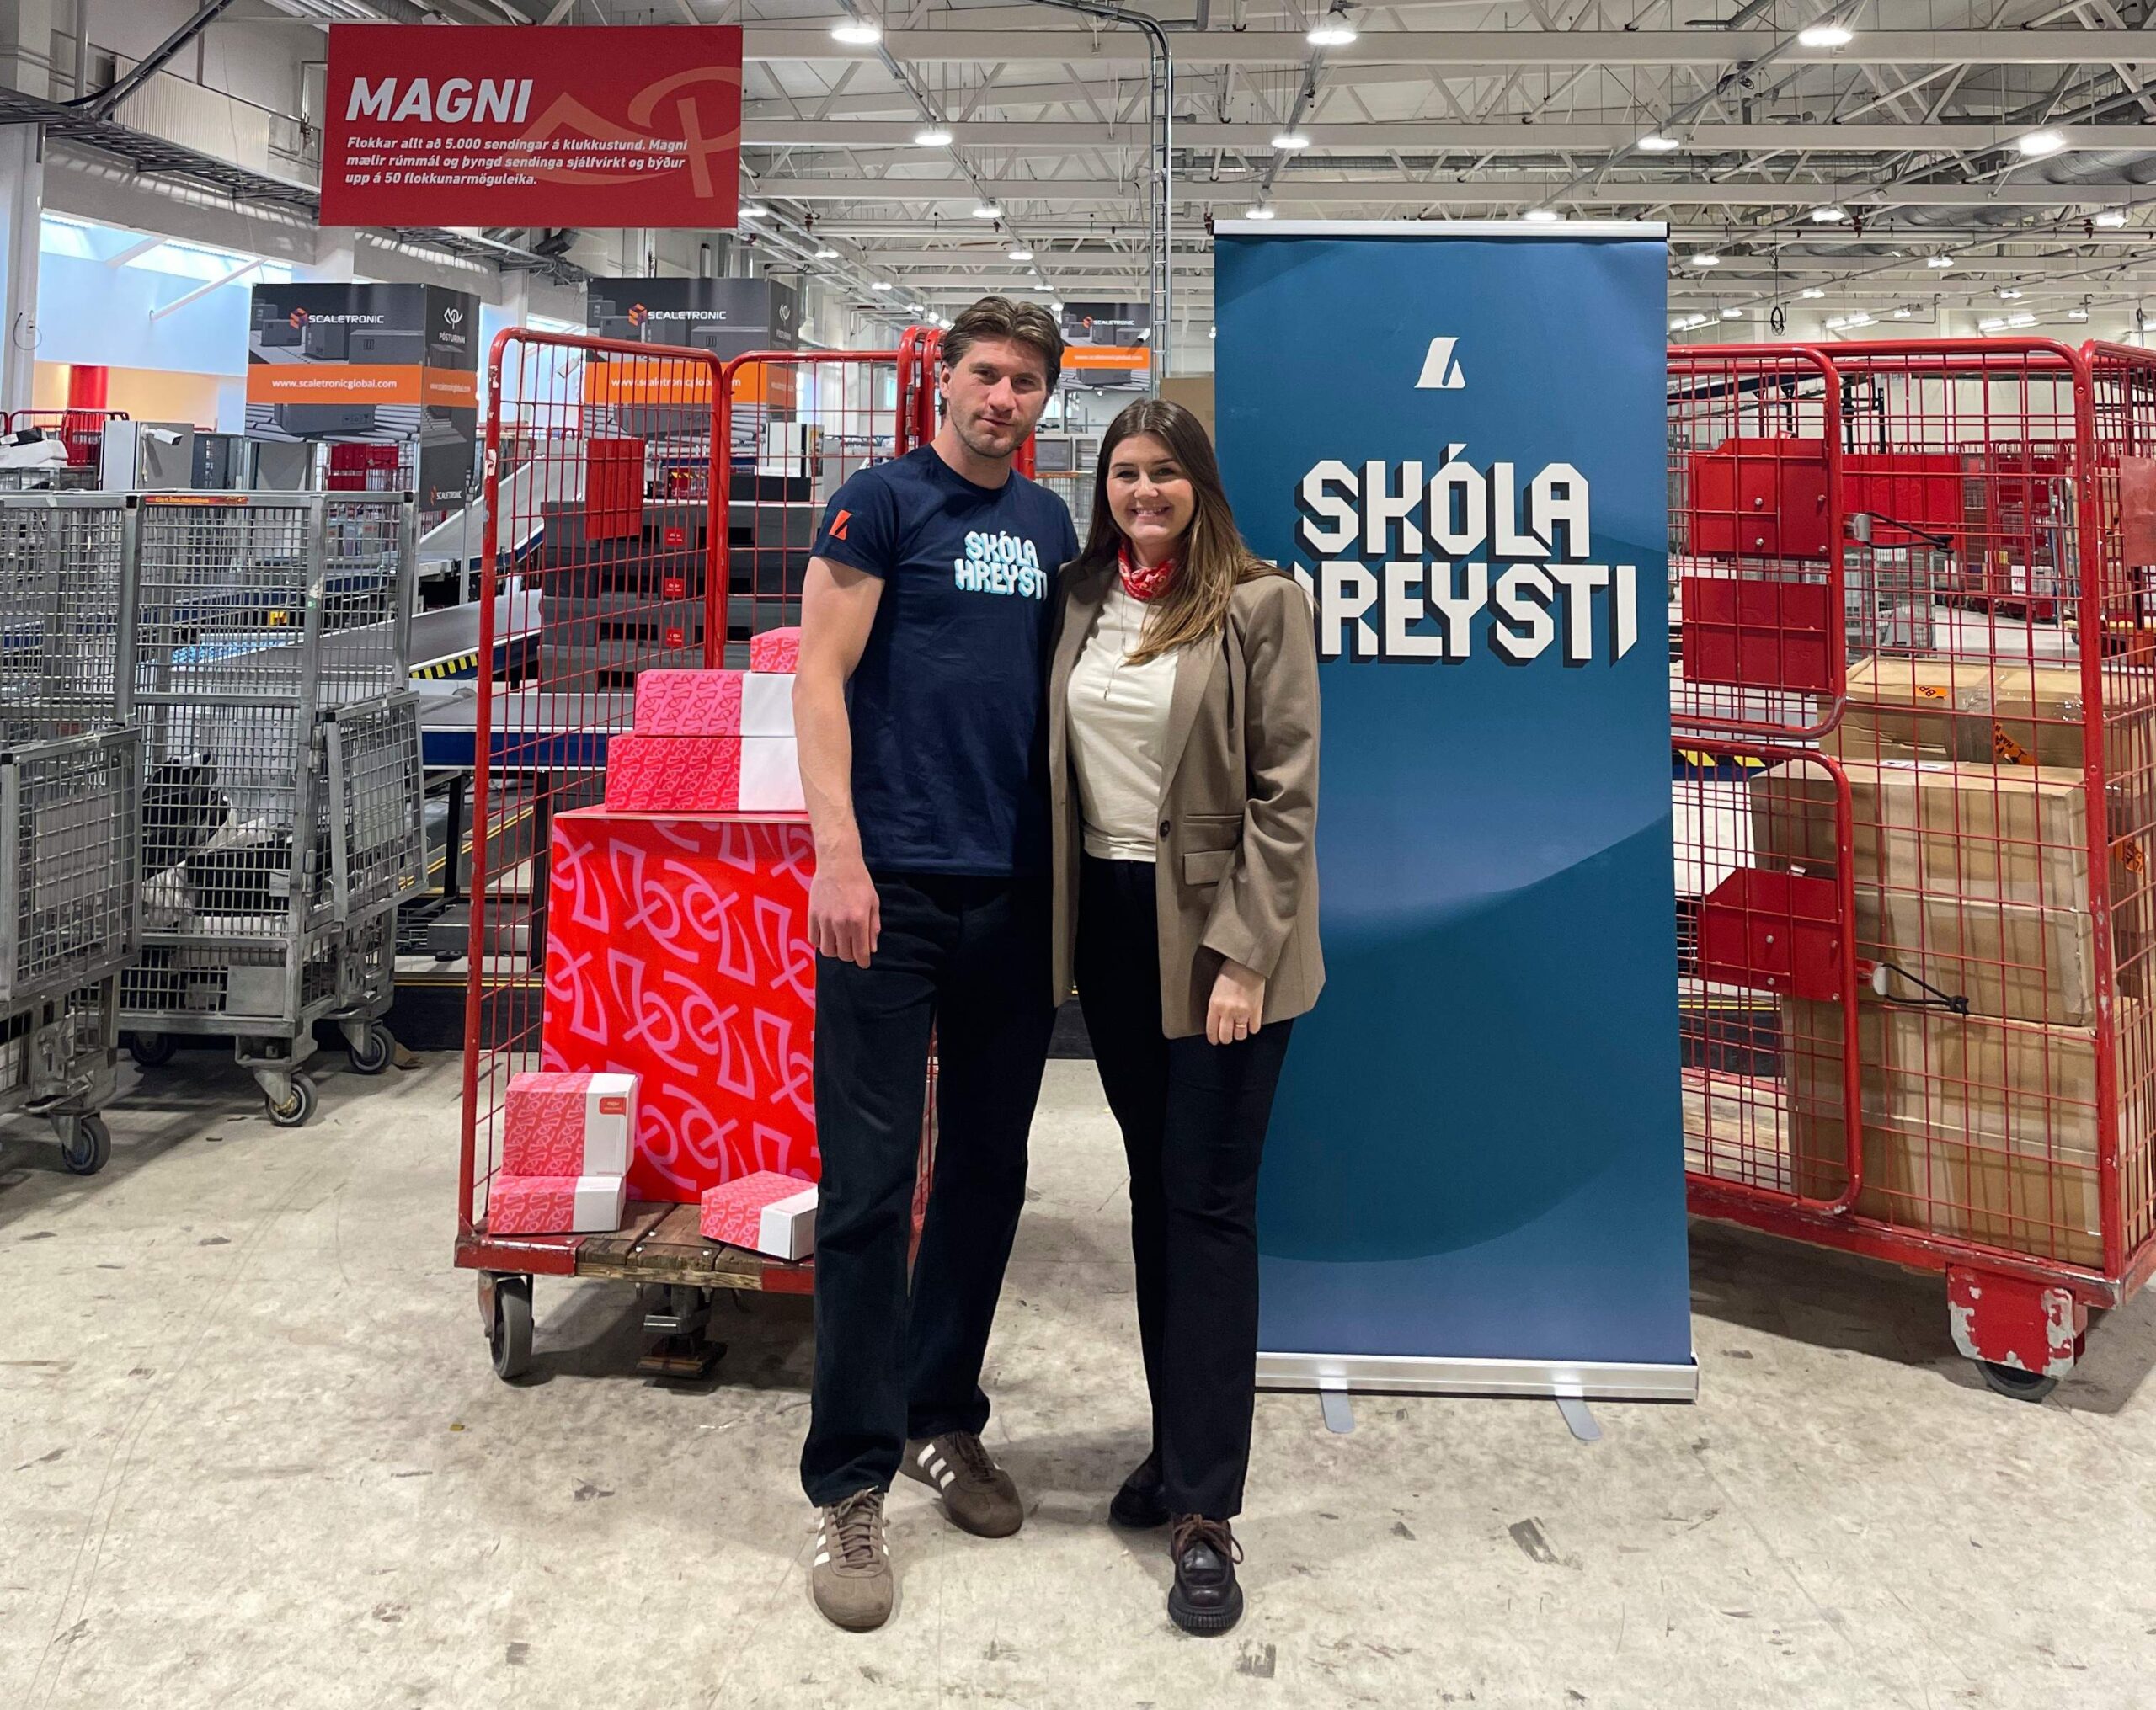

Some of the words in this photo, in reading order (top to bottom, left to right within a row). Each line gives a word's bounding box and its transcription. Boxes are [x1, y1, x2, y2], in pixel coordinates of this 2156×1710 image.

[345, 77, 533, 123] MAGNI
[347, 136, 398, 149] Flokkar
[400, 137, 424, 149] allt
[425, 138, 441, 150] að
[445, 138, 482, 150] 5.000
[483, 139, 550, 152] sendingar
[552, 139, 560, 151] á
[563, 139, 646, 151] klukkustund.
[648, 139, 688, 153] Magni
[346, 154, 387, 166] mælir
[388, 155, 440, 167] rúmmál
[442, 157, 459, 169] og
[461, 155, 504, 169] þyngd
[504, 157, 563, 170] sendinga
[566, 156, 626, 169] sjálfvirkt
[628, 158, 644, 171] og
[647, 156, 686, 171] býður
[345, 173, 371, 185] upp
[372, 172, 382, 184] á
[384, 173, 402, 184] 50
[403, 172, 537, 187] flokkunarmöguleika.
[308, 315, 385, 324] SCALETRONIC
[648, 311, 727, 320] SCALETRONIC
[271, 379, 398, 391] www.scaletronicglobal.com
[1295, 443, 1591, 559] SKÓLA
[964, 530, 1040, 568] SKÓLA
[953, 558, 1049, 601] HREYSTI
[1262, 560, 1638, 663] REYSTI
